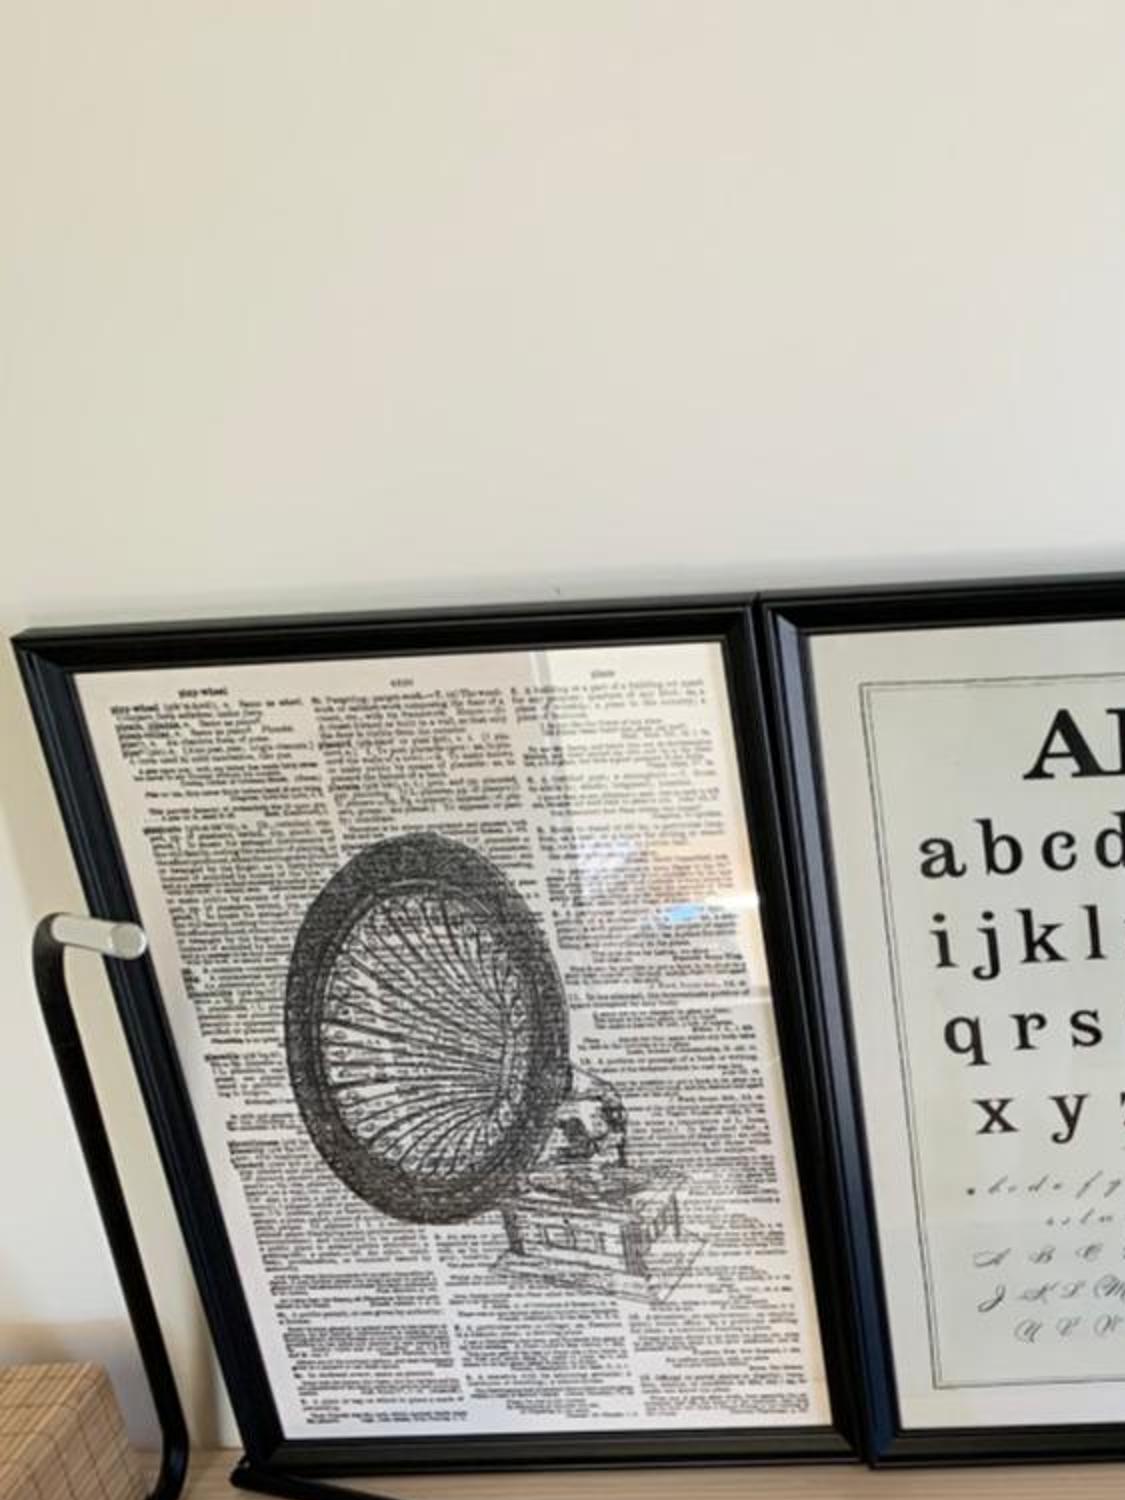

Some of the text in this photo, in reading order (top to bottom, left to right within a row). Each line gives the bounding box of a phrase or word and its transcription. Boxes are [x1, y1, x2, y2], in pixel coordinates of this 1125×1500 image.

[919, 837, 967, 879] a
[975, 818, 1023, 876] b
[1041, 830, 1077, 872] c
[931, 913, 956, 969] i
[972, 910, 1001, 981] j
[1016, 908, 1067, 964] k
[1083, 904, 1105, 960] l
[944, 1016, 989, 1066] q
[1011, 1012, 1047, 1051] r
[1069, 1009, 1103, 1048] s
[975, 1098, 1017, 1135] x
[1050, 1094, 1087, 1145] y
